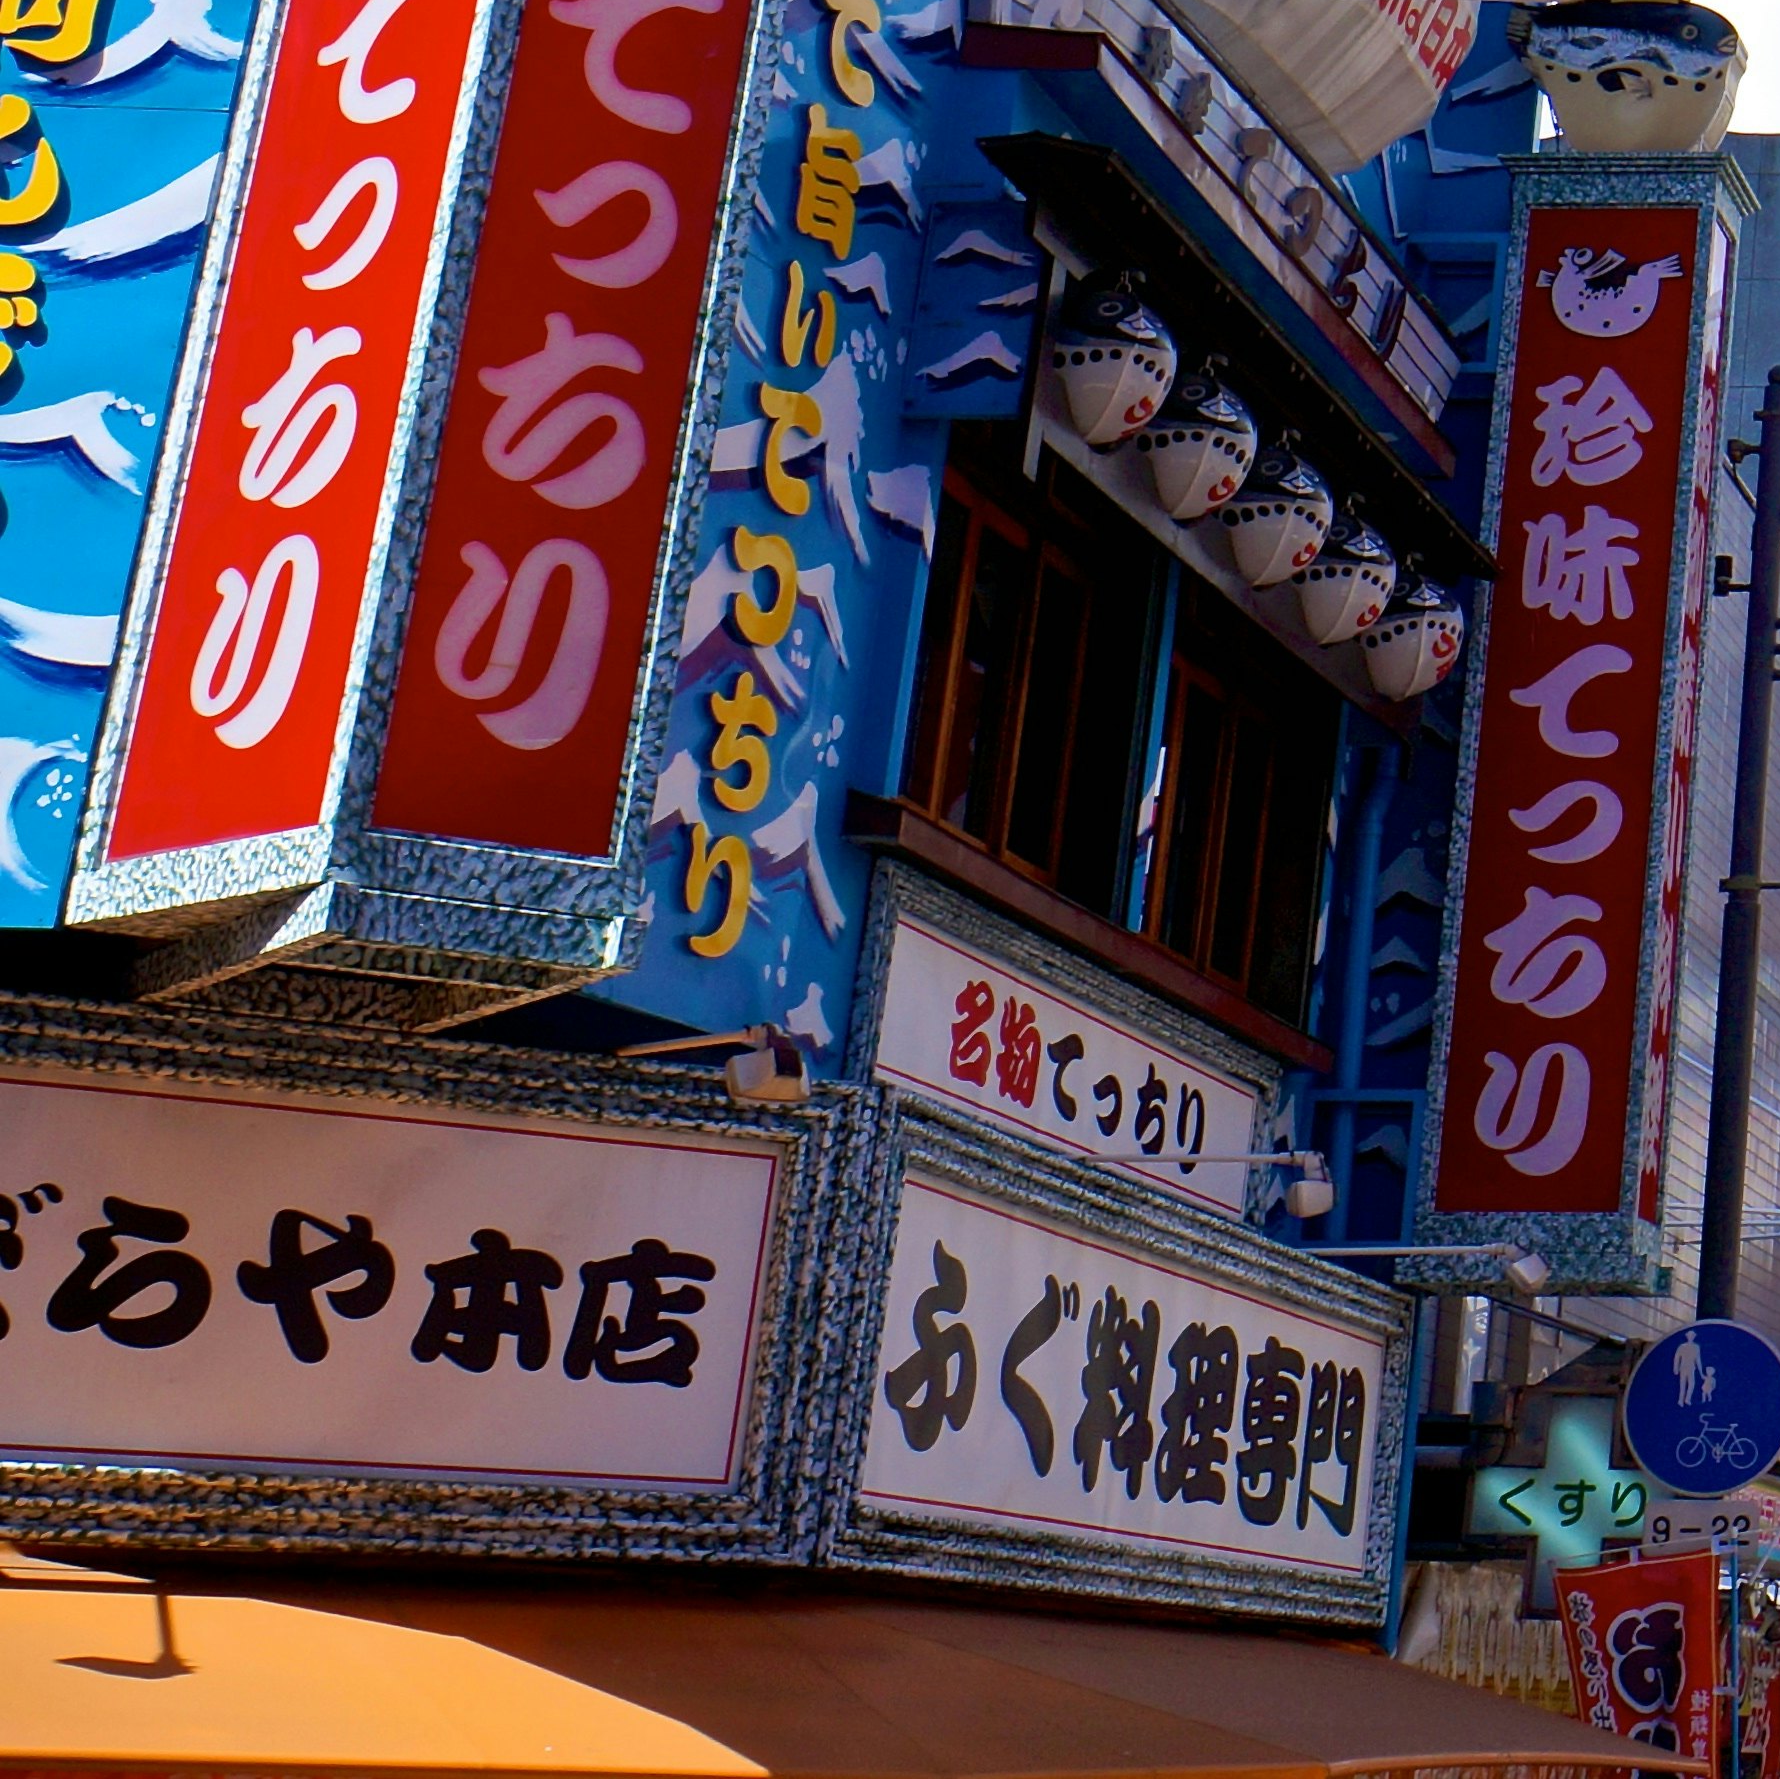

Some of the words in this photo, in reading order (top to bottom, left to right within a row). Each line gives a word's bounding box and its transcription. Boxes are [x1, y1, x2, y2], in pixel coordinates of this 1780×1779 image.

[1473, 365, 1653, 1177] 珍味てっちり
[947, 977, 1206, 1175] 名物てっちり
[0, 1180, 717, 1389] らや本店
[884, 1238, 1364, 1539] ふぐ料理専門
[1498, 1477, 1648, 1528] くすり
